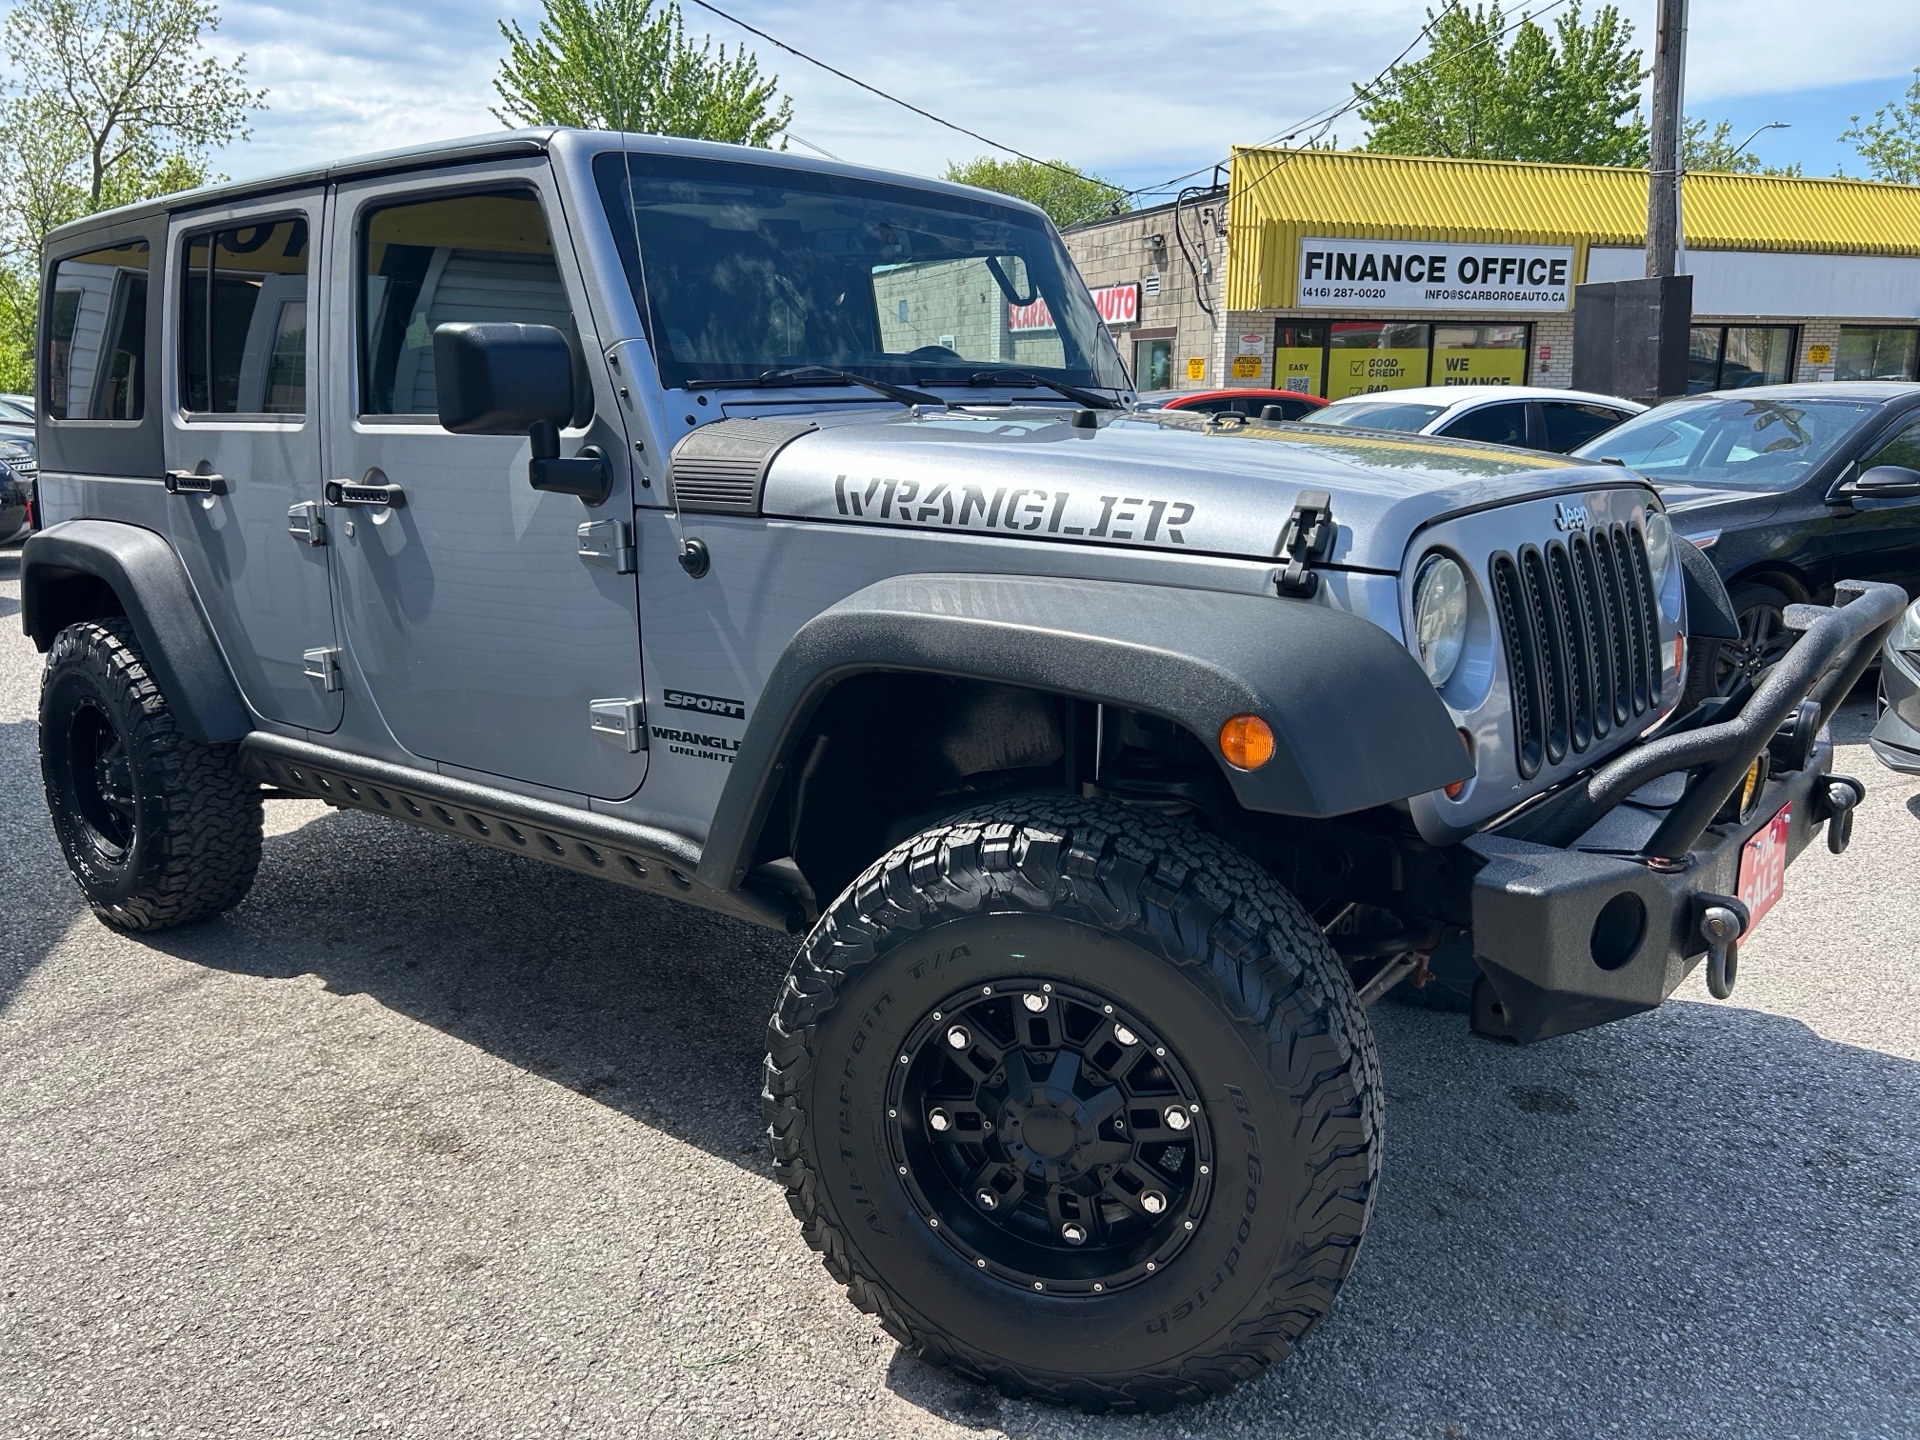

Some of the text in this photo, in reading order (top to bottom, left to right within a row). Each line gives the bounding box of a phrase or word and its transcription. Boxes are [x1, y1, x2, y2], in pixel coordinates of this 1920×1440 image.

[1304, 251, 1568, 286] FINANCE OFFICE
[1097, 287, 1135, 320] AUTO
[1303, 287, 1386, 299] (416) 287-0020
[1424, 289, 1566, 303] INFO@SCARBOROEAUTO.CA
[1288, 363, 1310, 371] EASY
[1368, 368, 1406, 378] CREDIT
[1369, 358, 1399, 368] GOOD
[1445, 357, 1470, 372] WE
[1367, 384, 1389, 394] BAD
[834, 474, 1196, 545] WRANGLER
[1553, 502, 1590, 532] Jeep
[666, 692, 745, 716] SPORT
[650, 725, 742, 752] WRANGLE
[668, 744, 736, 764] UNLIMITE
[1752, 827, 1778, 875] FOR
[1743, 853, 1781, 916] SALE
[904, 941, 975, 982] T/A
[1142, 1082, 1265, 1336] BFGoodrich
